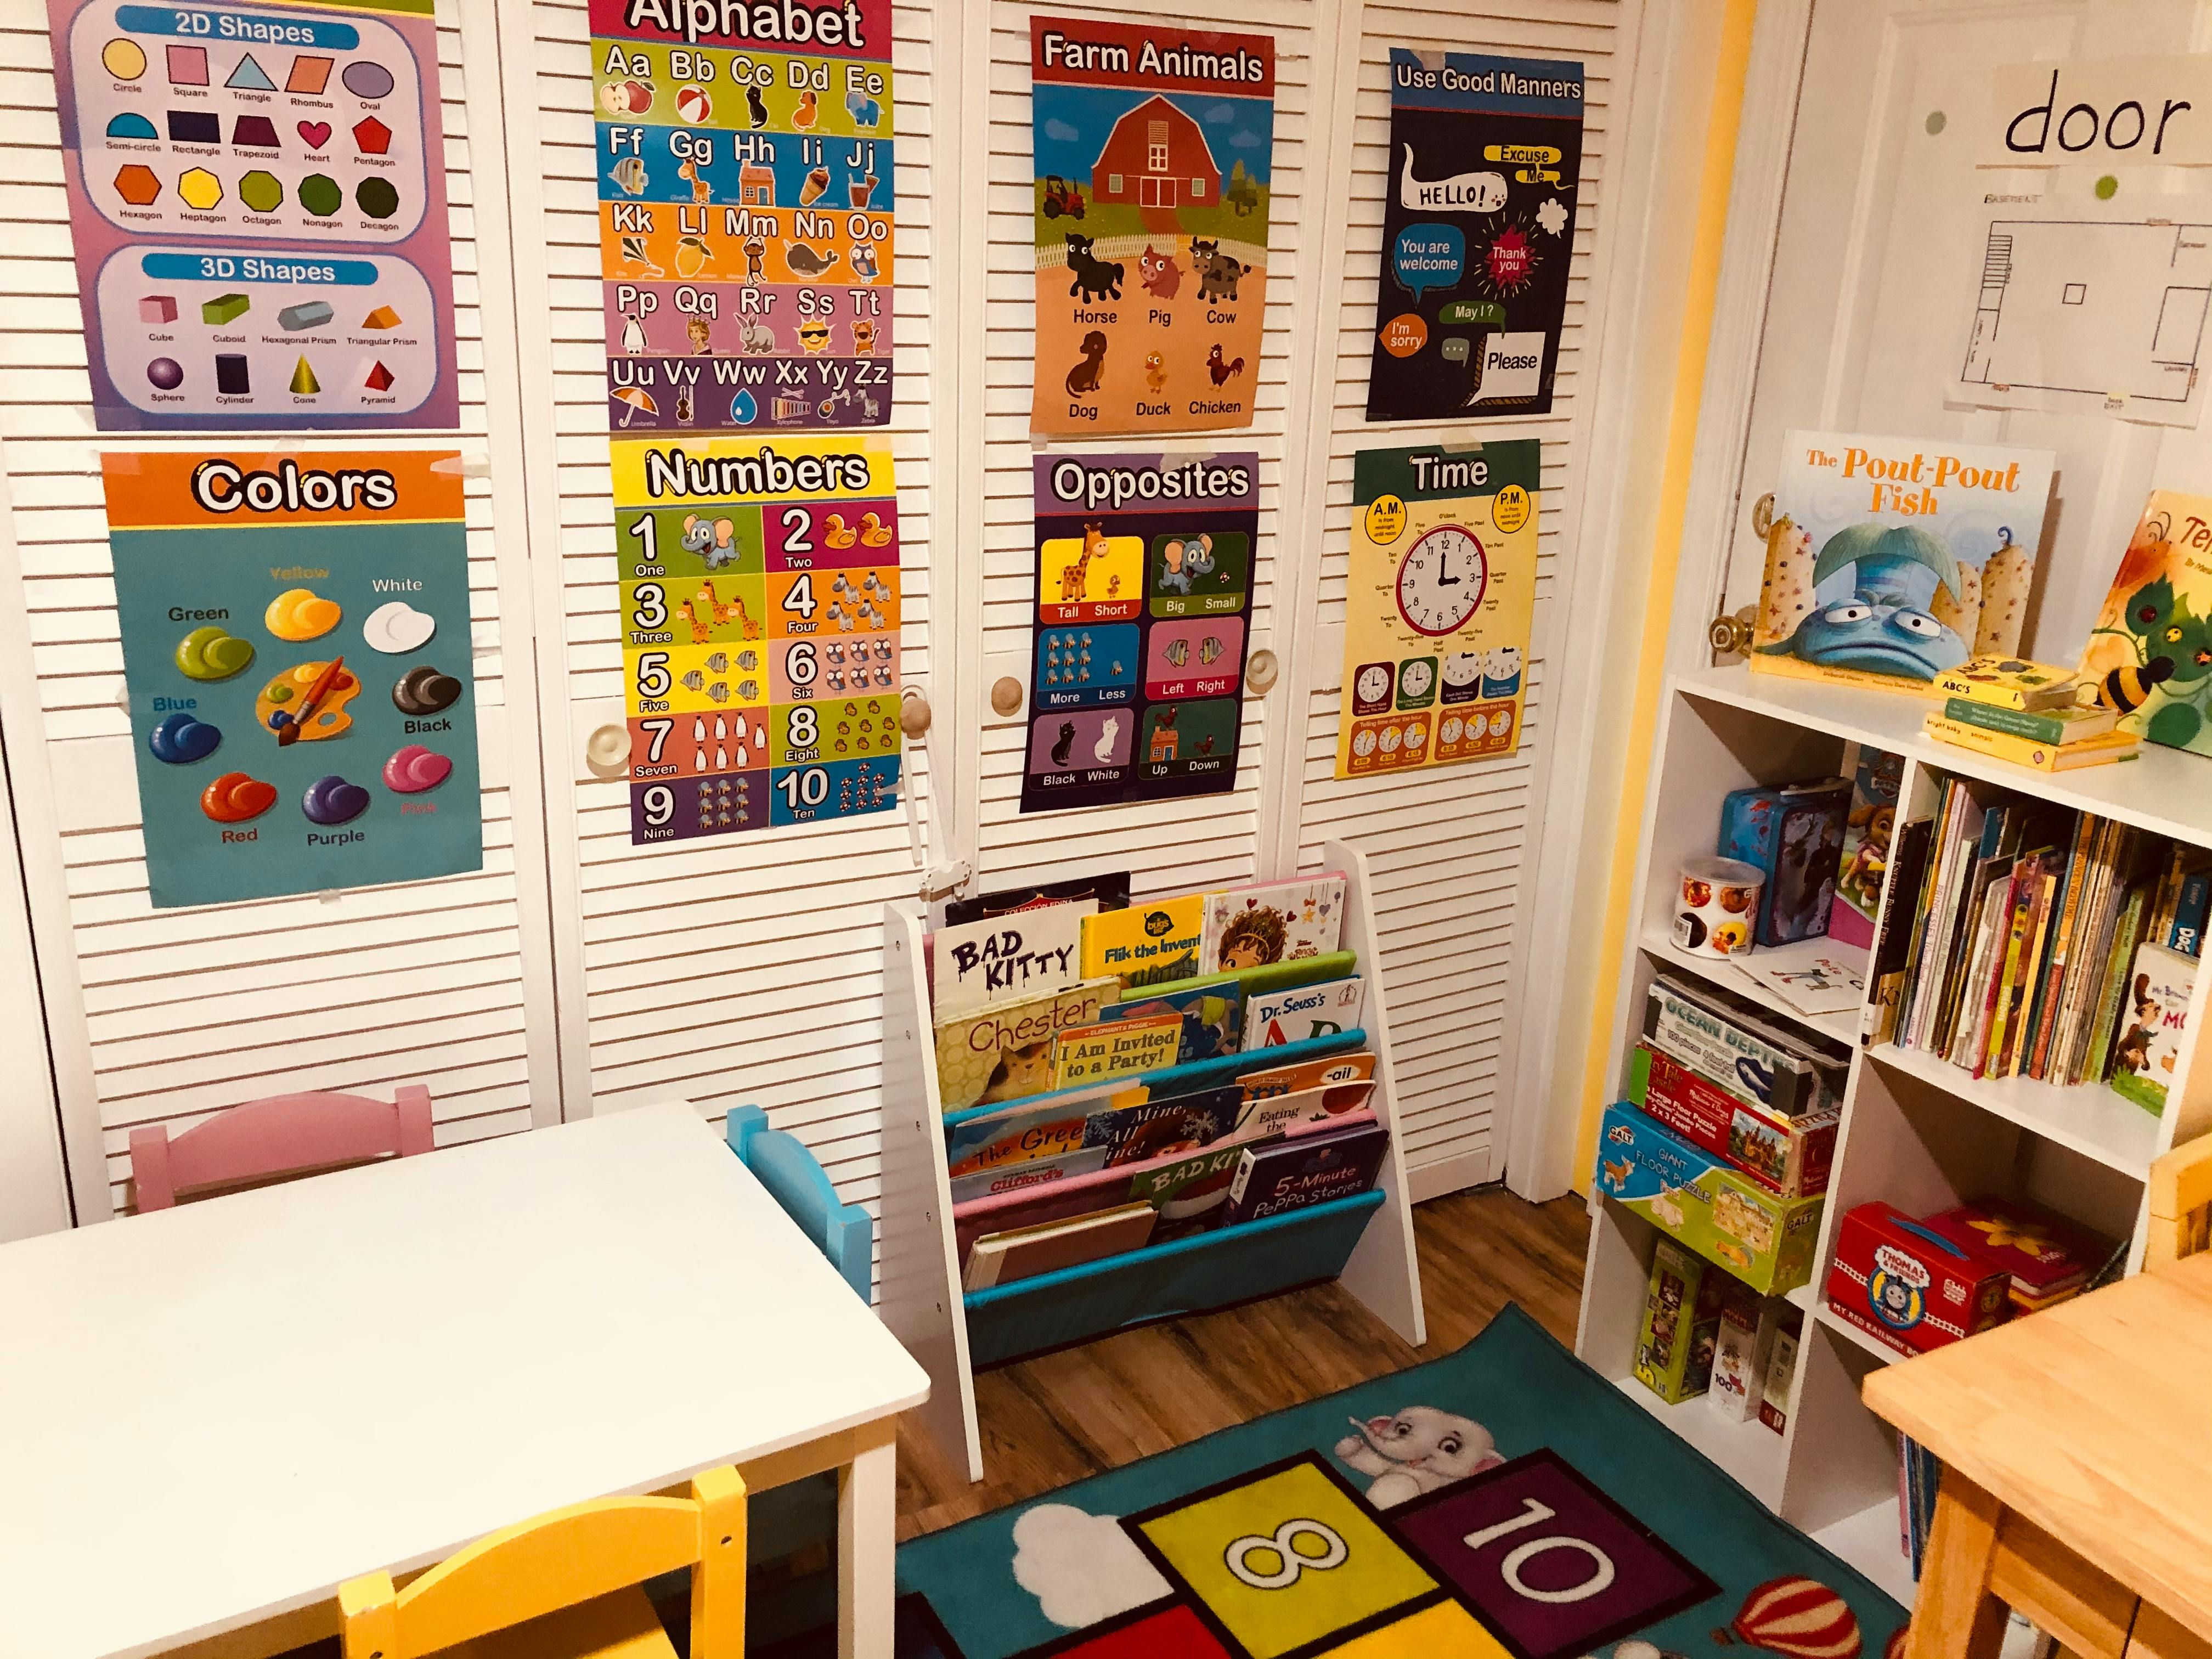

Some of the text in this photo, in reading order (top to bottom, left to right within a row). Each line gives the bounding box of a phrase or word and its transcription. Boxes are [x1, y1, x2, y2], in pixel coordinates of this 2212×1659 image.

[176, 12, 314, 43] 2D Shapes
[625, 0, 865, 48] Alphabet
[1043, 31, 1264, 83] Farm Animals
[605, 45, 883, 95] Aa Bb Cc Dd Ee
[1396, 64, 1582, 99] Use Good Manners
[113, 83, 380, 110] Circle Square Triangle Rhombus Oval
[2005, 69, 2191, 154] door
[106, 141, 395, 167] Semi-circle Rectangle Trapezoid Heart Pentagon
[1500, 145, 1549, 162] Excuse
[1527, 170, 1544, 182] Me
[1420, 184, 1486, 207] HELLO!
[120, 210, 399, 232] Hexagon Heptagon Octagon Nonagon Decagon
[1402, 239, 1449, 253] You are
[1493, 247, 1526, 259] Thank
[201, 257, 335, 283] 3D Shapes
[1400, 257, 1458, 270] welcome
[1499, 259, 1519, 273] you
[1074, 309, 1236, 326] Horse Pig Cow
[1455, 305, 1494, 320] May I ?
[1392, 322, 1409, 334] I'm
[149, 334, 417, 346] Cube Cuboid Hexagonal Prism Triangular Prism
[1391, 335, 1422, 350] sorry
[1487, 352, 1537, 370] Please
[151, 393, 184, 402] Sphere
[216, 396, 254, 405] Cylinder
[360, 396, 395, 405] Pyramid
[1069, 401, 1241, 420] Dog Duck Chicken
[646, 447, 870, 498] Numbers
[1409, 453, 1489, 491] Time
[1807, 447, 2020, 493] The Pout-Pout
[191, 458, 397, 512] Colors
[1051, 458, 1250, 511] Opposites
[1374, 492, 1523, 515] A.M. P.M.
[1867, 482, 1938, 516] Fish
[629, 507, 813, 561] 1 2
[270, 566, 329, 580] Yellow
[635, 557, 812, 577] One Two
[373, 579, 423, 592] White
[168, 606, 229, 621] Green
[1058, 597, 1235, 618] Tall Short Big Small
[1957, 658, 1995, 675] ABC'S
[1050, 680, 1224, 704] More Less Left Right
[1942, 681, 1971, 695] ABC'S
[153, 696, 197, 711] Blue
[404, 719, 452, 733] Black
[1043, 760, 1219, 785] Black White Up Down
[400, 802, 437, 815] Pink
[222, 830, 365, 847] Red Purple
[951, 930, 1023, 979] BAD
[1105, 946, 1131, 963] Flik
[1134, 944, 1157, 958] the
[986, 944, 1074, 995] KITTY
[1261, 992, 1325, 1023] Dr. Seuss's
[1664, 996, 1723, 1039] OCEAN
[969, 998, 1096, 1052] Chester
[1090, 1026, 1121, 1035] ELEPHANT
[1061, 1046, 1069, 1061] I
[1075, 1043, 1105, 1059] Am
[1112, 1030, 1175, 1053] Invited
[1067, 1064, 1084, 1078] to
[1091, 1061, 1102, 1073] a
[1108, 1048, 1164, 1070] Party!
[1327, 1066, 1351, 1081] -ail
[1131, 1103, 1187, 1124] Mine,
[1259, 1107, 1300, 1124] Eating
[1651, 1104, 1657, 1113] 2
[1664, 1112, 1670, 1120] 3
[1671, 1116, 1691, 1132] Feet!
[1652, 1087, 1672, 1104] Large
[1673, 1101, 1692, 1116] Floor
[1693, 1113, 1717, 1132] Puzzle
[1108, 1125, 1139, 1145] All
[1267, 1122, 1286, 1132] the
[1609, 1126, 1634, 1144] GALT
[973, 1144, 1011, 1166] The
[1658, 1148, 1689, 1171] GIANT
[990, 1169, 1064, 1192] Clifford's
[1152, 1159, 1205, 1193] BAD
[1274, 1166, 1356, 1197] 5-Minute
[1635, 1149, 1670, 1179] FLOOR
[1672, 1172, 1712, 1204] PUZZLE
[1253, 1178, 1363, 1220] Peppa Stories
[1881, 1249, 1925, 1280] THOMAS
[1833, 1302, 1906, 1351] MY RED RAILWAY
[1715, 1373, 1733, 1393] 100
[1222, 1517, 1348, 1589] 8
[1462, 1497, 1617, 1605] 10
